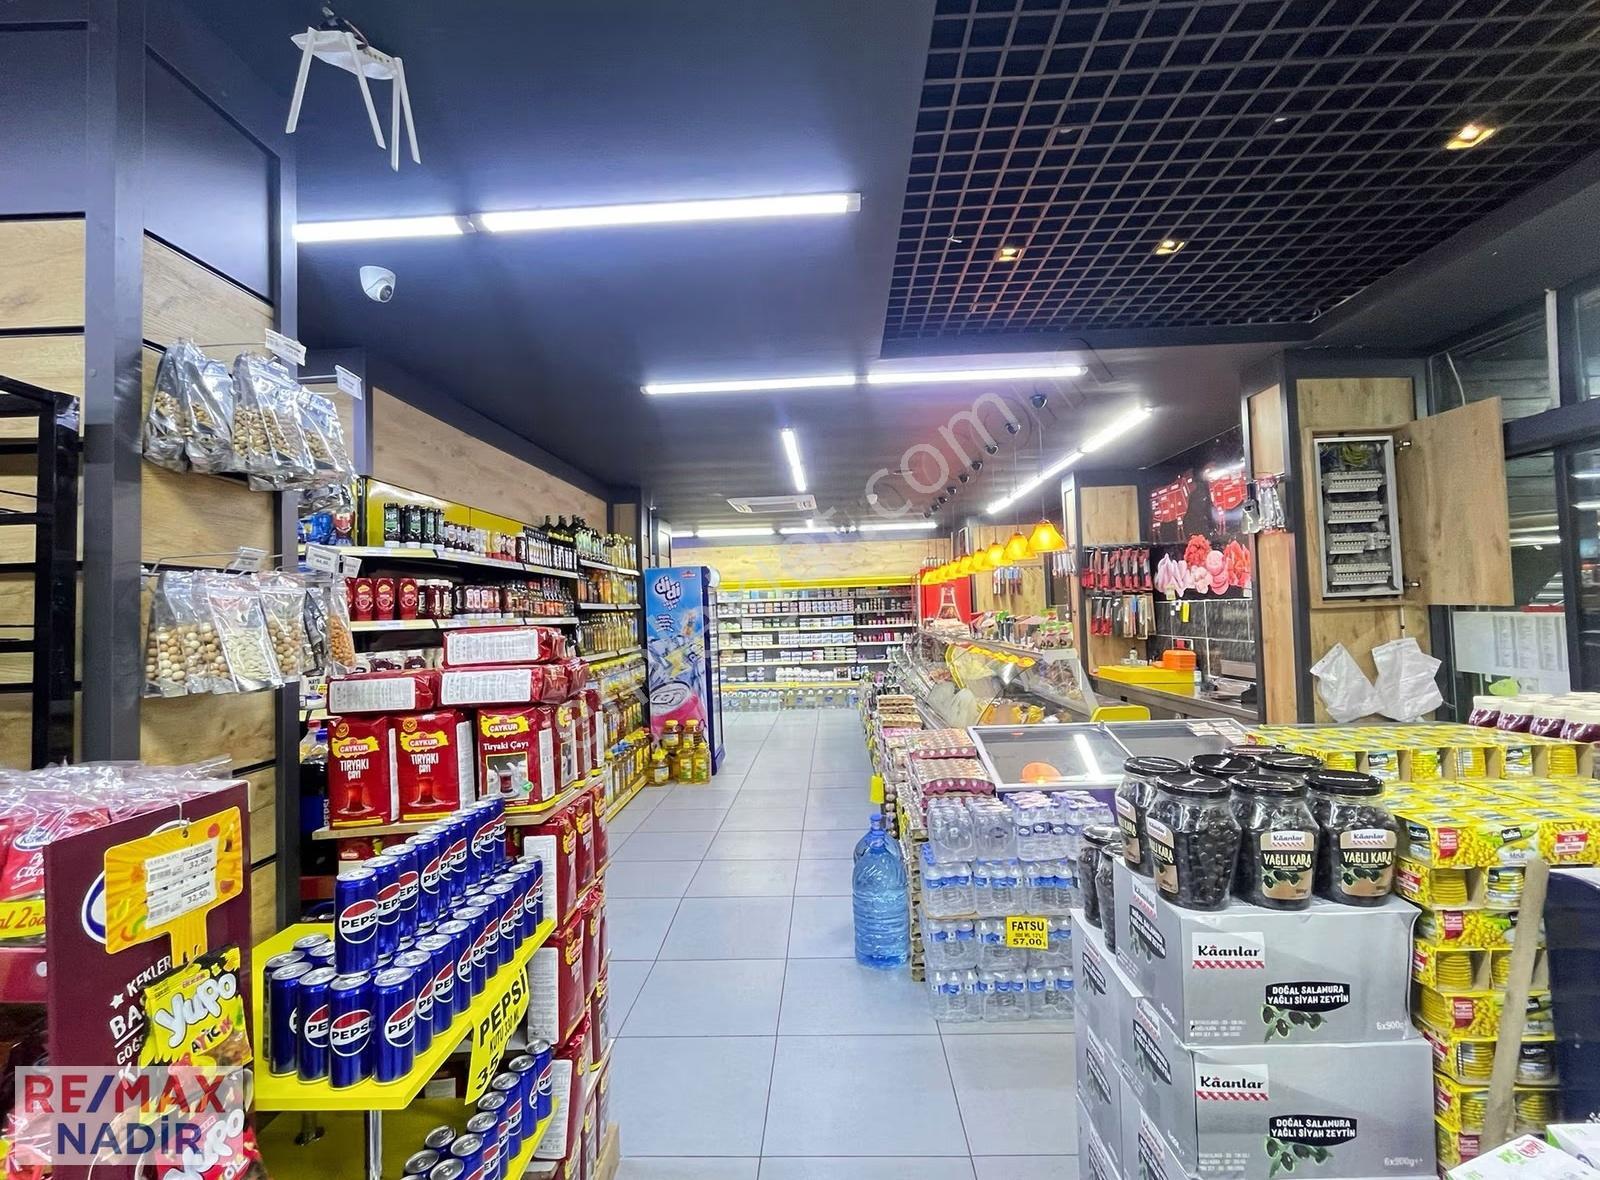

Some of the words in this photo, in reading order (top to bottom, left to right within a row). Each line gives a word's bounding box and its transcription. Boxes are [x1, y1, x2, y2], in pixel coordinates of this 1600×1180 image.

[483, 742, 508, 752] Tiryaki
[510, 740, 529, 750] Çayı
[1290, 853, 1312, 868] KARA
[1370, 851, 1392, 866] KARA
[341, 912, 377, 929] PEPS
[1011, 921, 1044, 931] FATSU
[1197, 944, 1261, 957] Kâanlar
[1272, 984, 1300, 995] DOĞAL
[1301, 985, 1344, 995] SALAMURA
[1267, 994, 1293, 1005] YAĞLI
[1294, 993, 1319, 1005] SİYAH
[1320, 993, 1349, 1004] ZEYTİN
[1200, 1076, 1264, 1090] Kâanlar
[1276, 1118, 1304, 1128] DOĞAL
[1305, 1118, 1351, 1128] SALAMURA
[1271, 1127, 1297, 1138] YAĞLI
[1298, 1127, 1324, 1138] SİYAH
[1325, 1127, 1356, 1138] ZEYTİN
